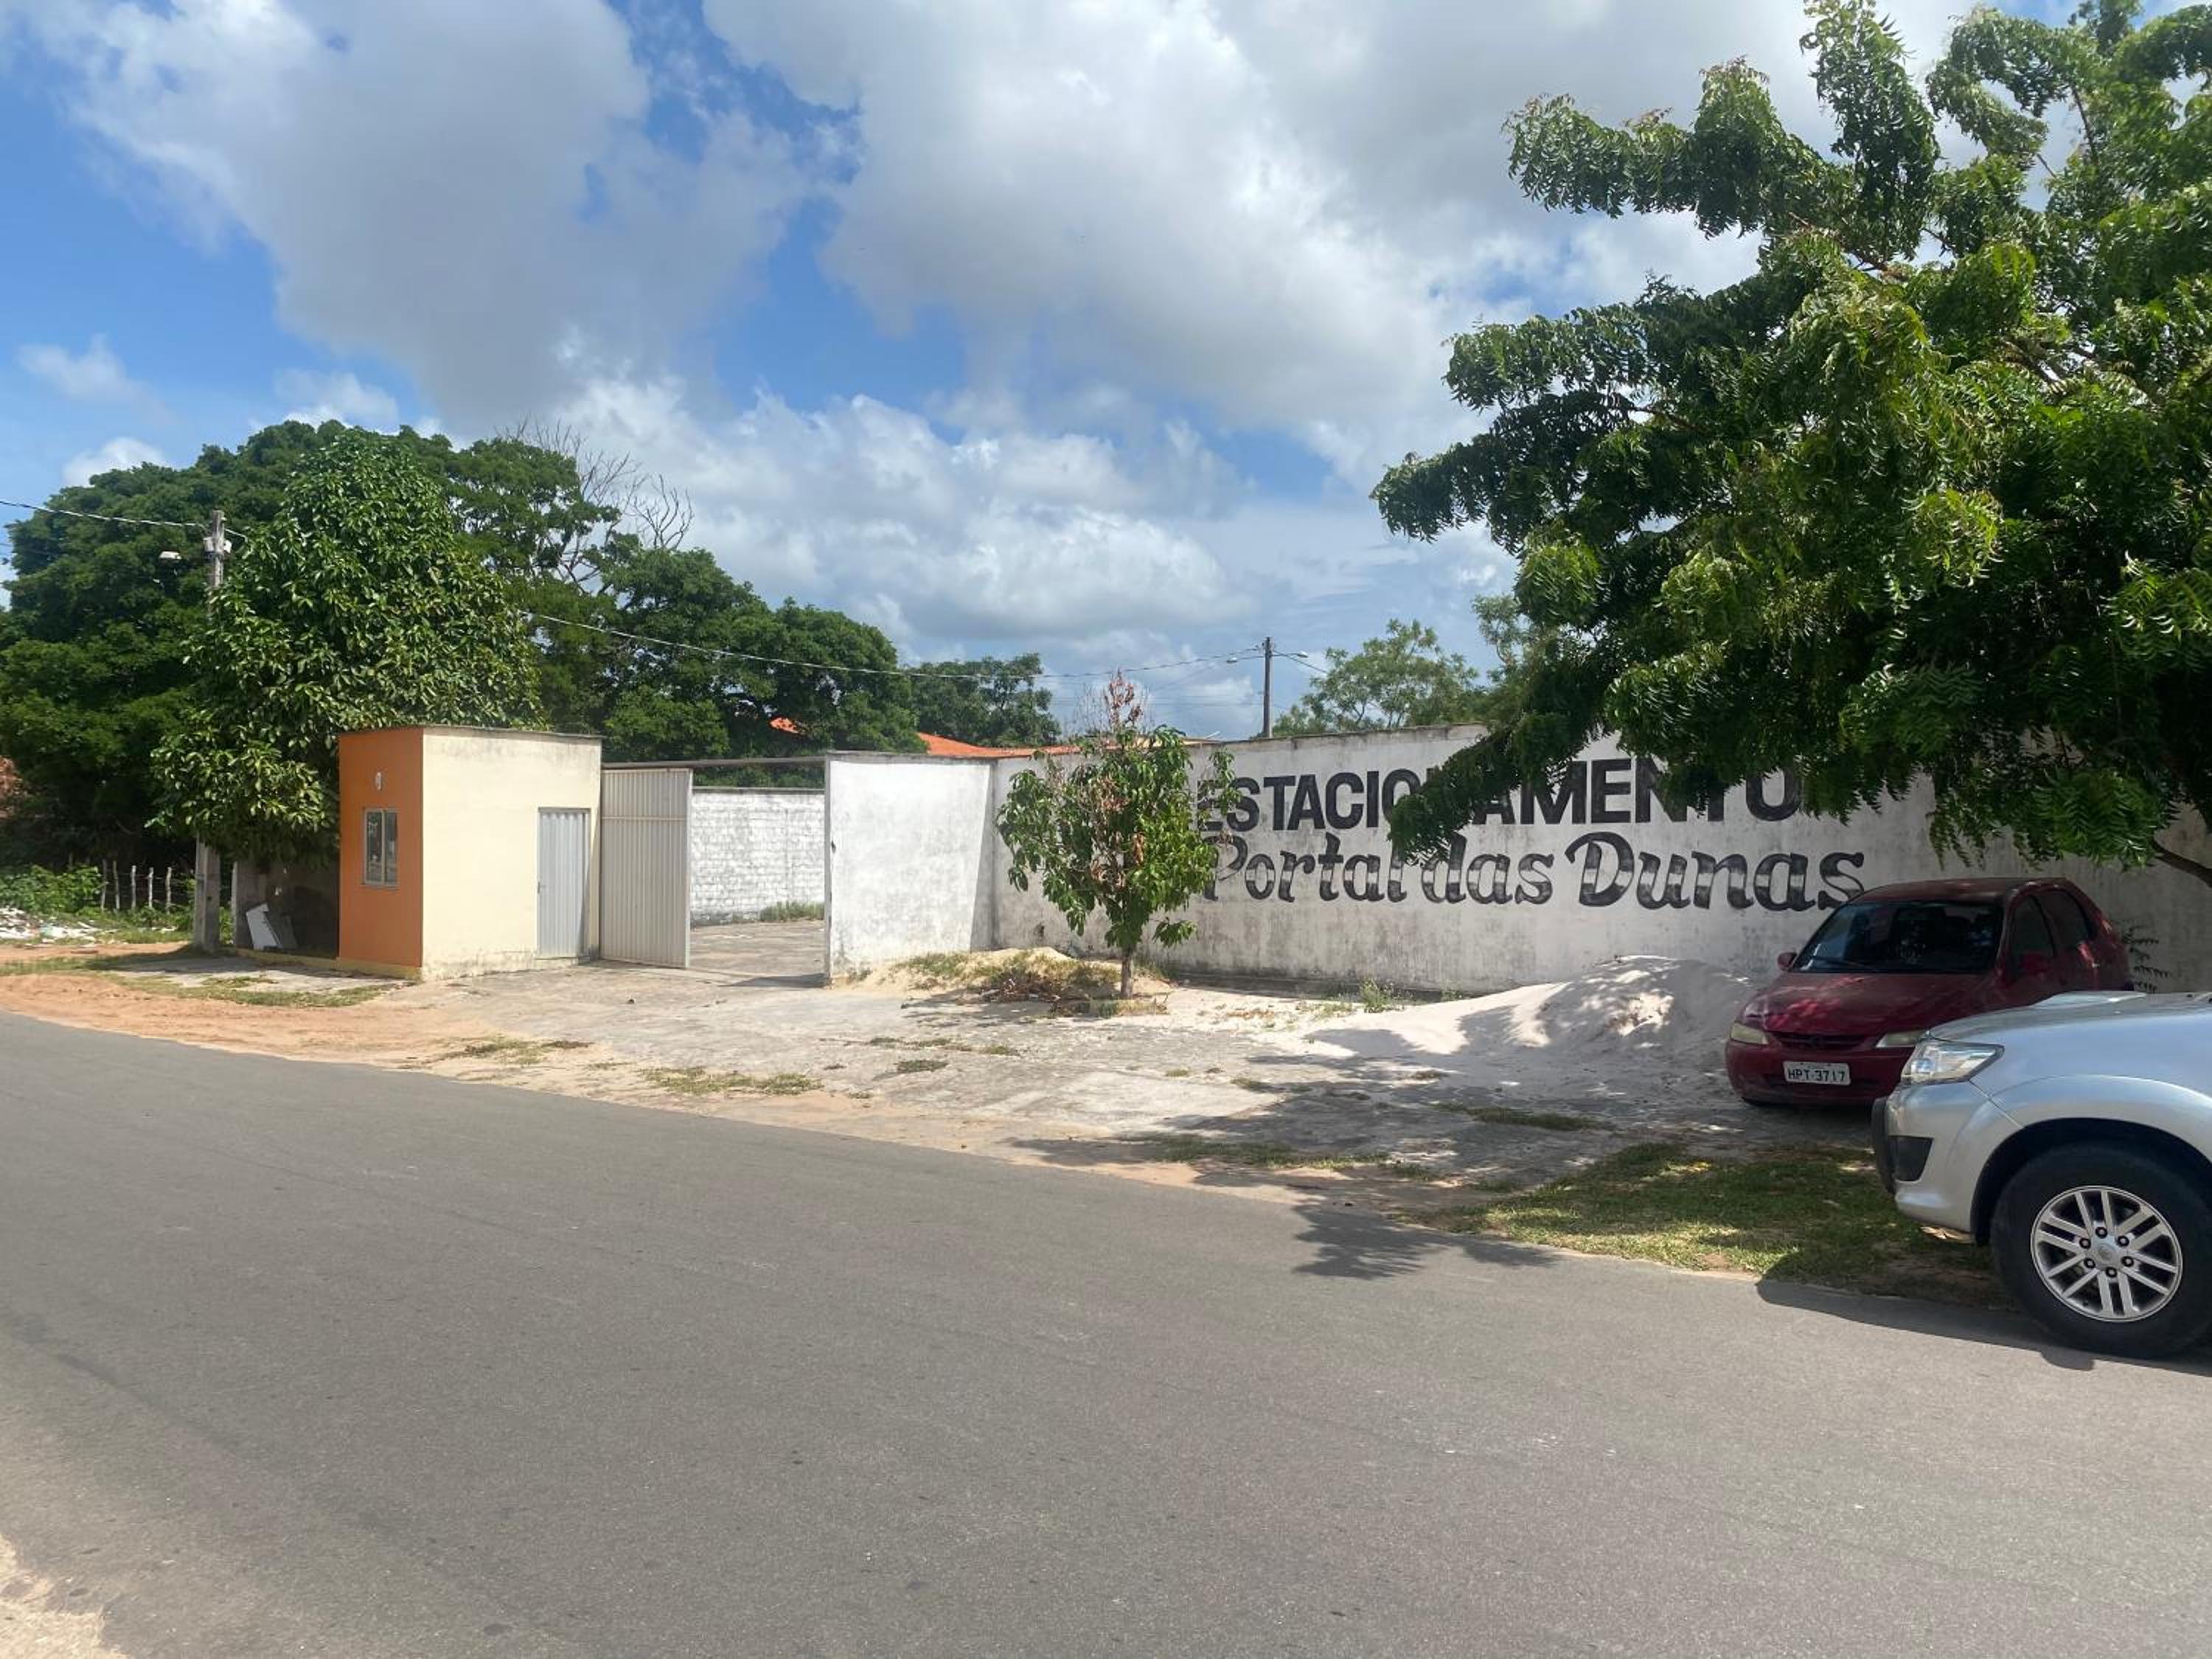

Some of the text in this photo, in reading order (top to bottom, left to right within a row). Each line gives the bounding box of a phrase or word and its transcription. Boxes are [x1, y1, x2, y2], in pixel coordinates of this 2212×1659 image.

[1203, 832, 1865, 911] Portal das Dunas
